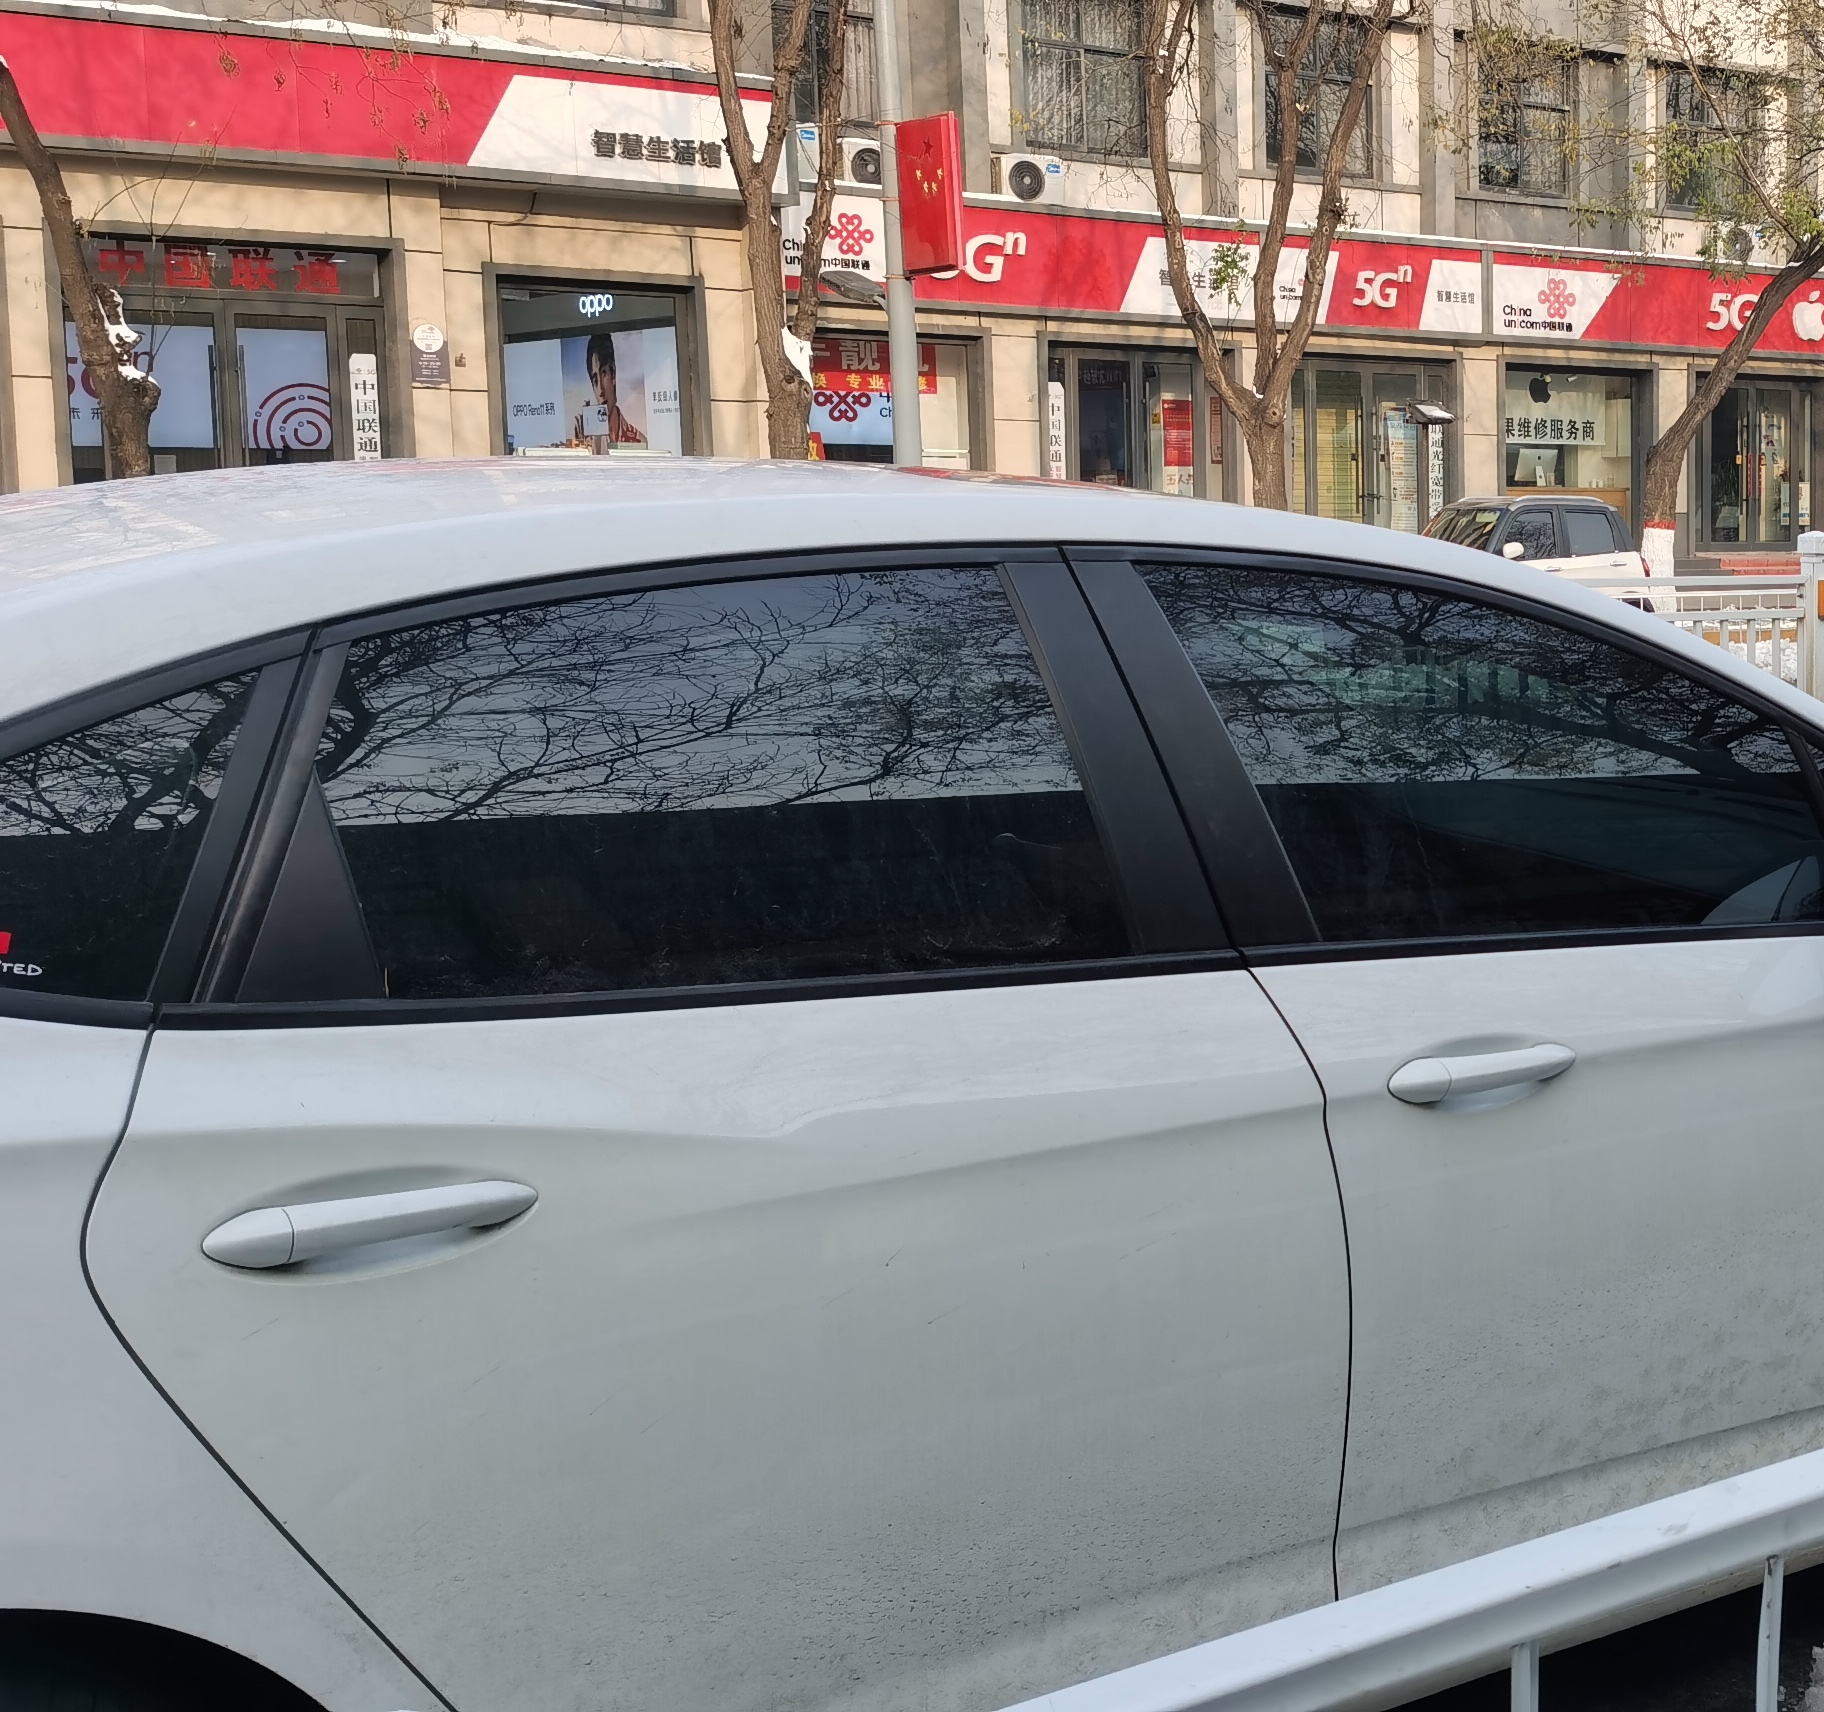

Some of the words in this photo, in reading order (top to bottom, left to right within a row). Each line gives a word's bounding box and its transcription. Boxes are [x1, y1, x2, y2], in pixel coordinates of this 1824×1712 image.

[591, 129, 722, 168] 智慧生活馆
[98, 240, 341, 294] 中国联通
[1437, 290, 1475, 304] 智慧生活馆
[1503, 304, 1532, 317] China
[354, 379, 379, 453] 中国联通
[1505, 417, 1596, 442] 果维修服务商
[0, 959, 43, 976] TED
